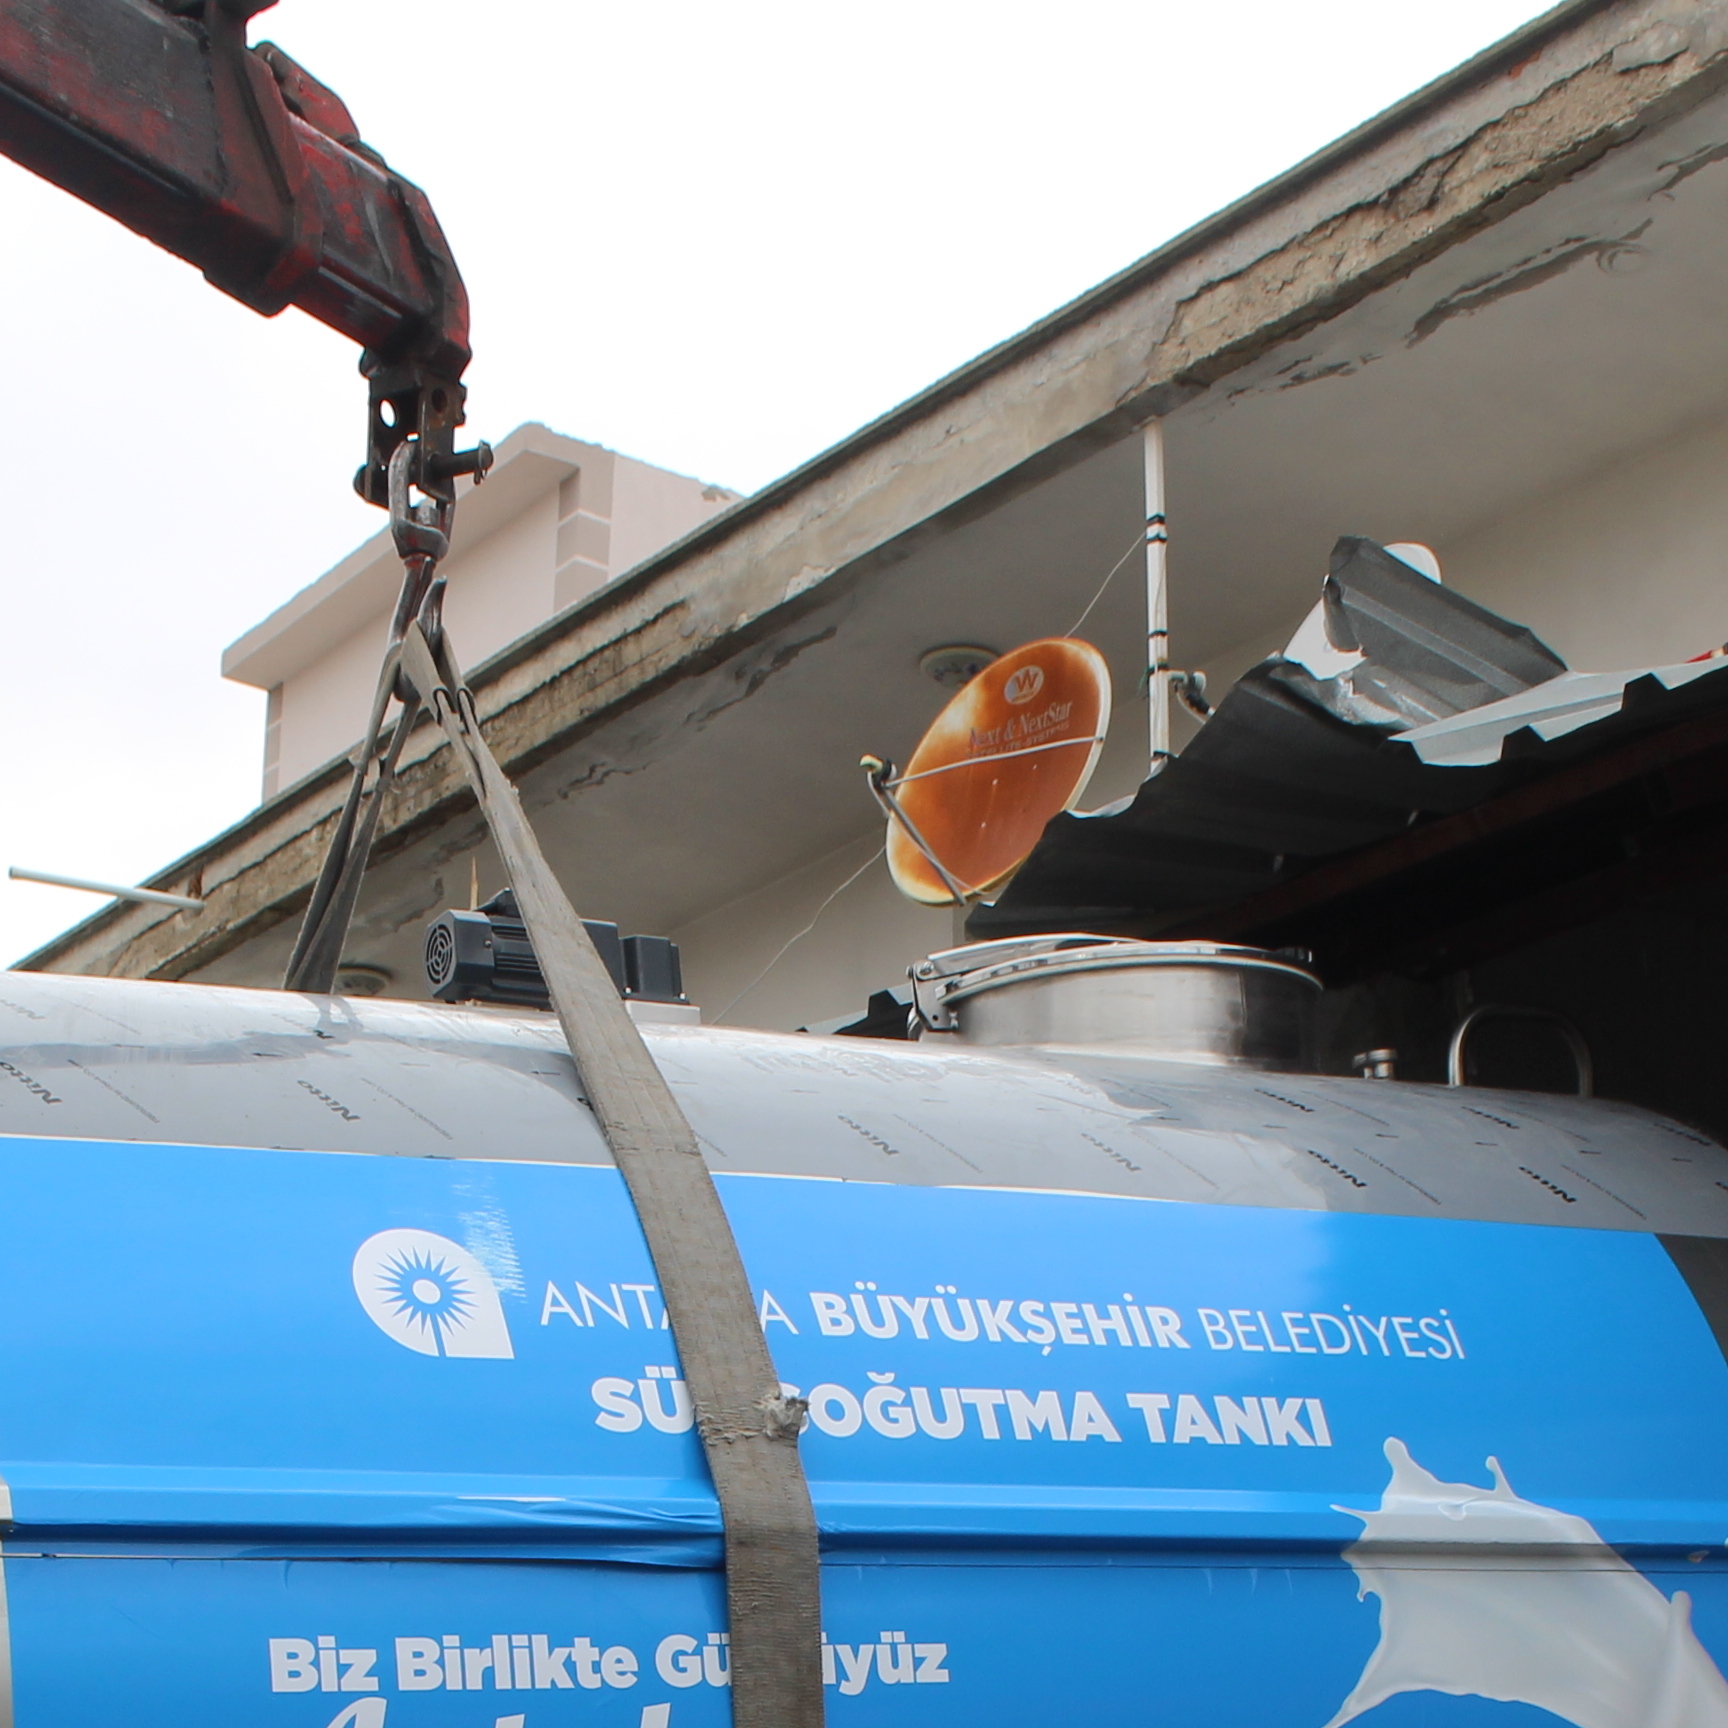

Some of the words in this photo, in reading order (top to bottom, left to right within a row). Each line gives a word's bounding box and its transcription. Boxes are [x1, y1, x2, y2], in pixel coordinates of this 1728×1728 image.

[296, 1079, 361, 1122] Nitto
[540, 1279, 799, 1335] ANTA
[809, 1281, 1191, 1357] BÜYÜKŞEHİR
[1197, 1303, 1466, 1360] BELEDİYESİ
[590, 1365, 695, 1435] SÜ
[1126, 1393, 1332, 1447] TANKI
[268, 1635, 379, 1693] Biz
[395, 1633, 639, 1691] Birlikte
[654, 1630, 951, 1697] Güyüz
